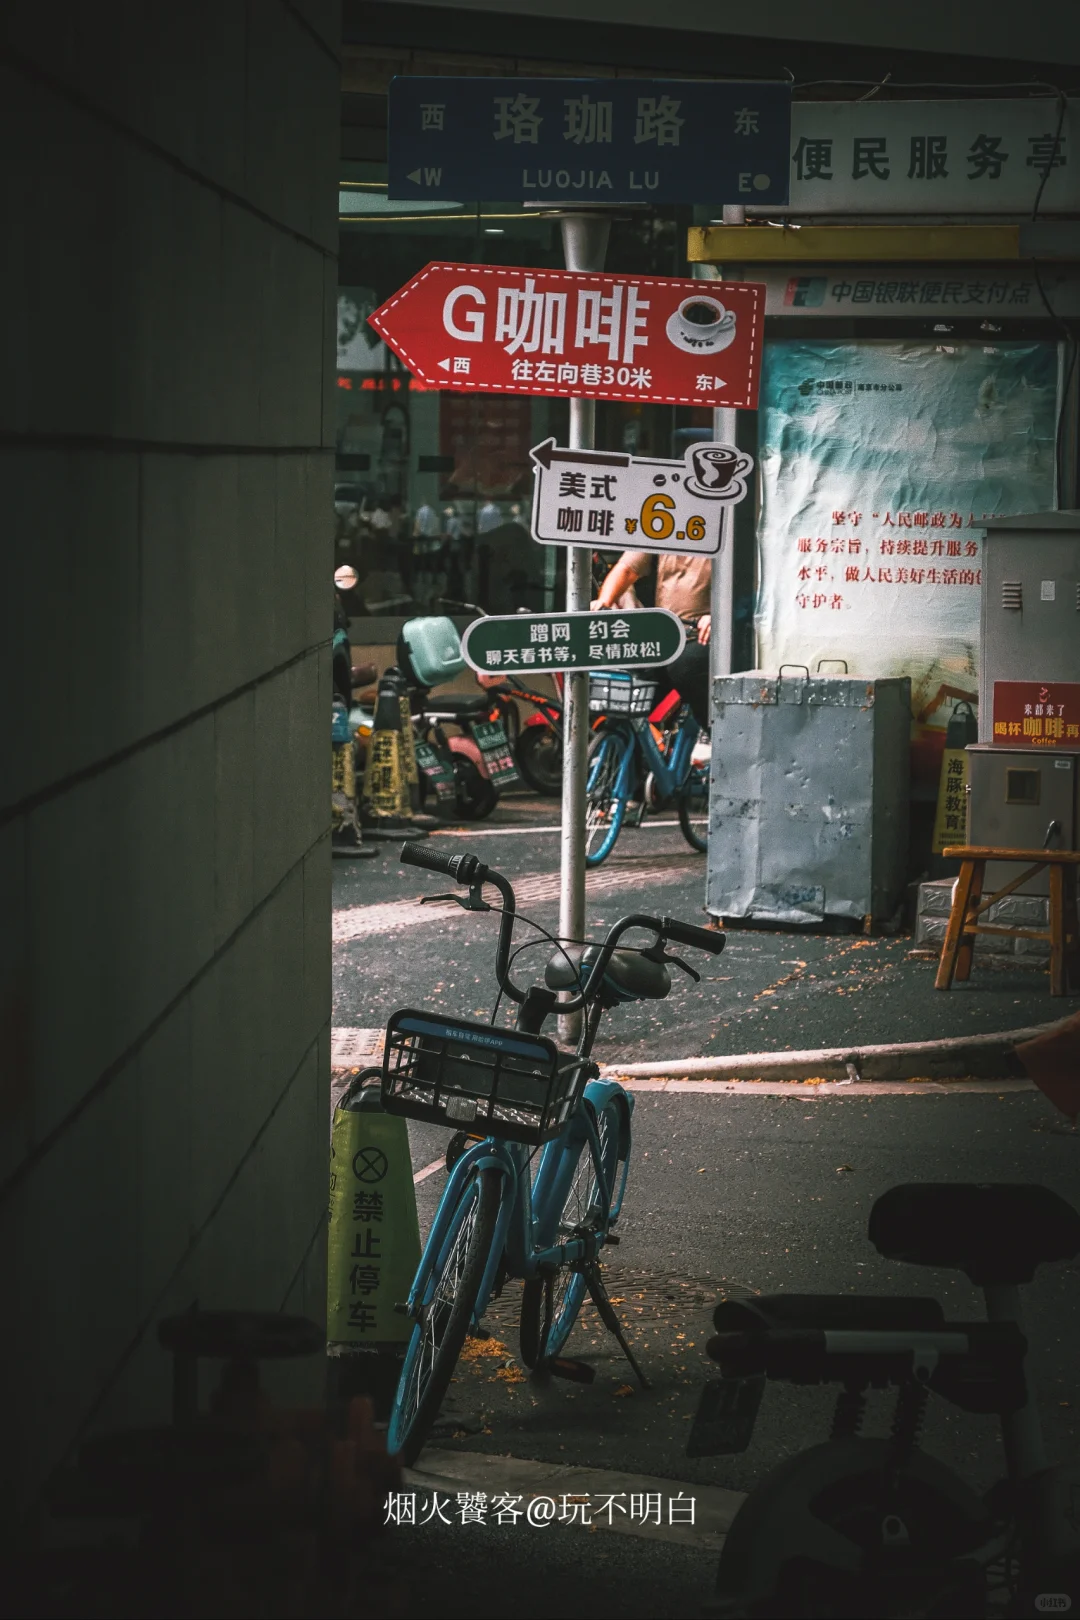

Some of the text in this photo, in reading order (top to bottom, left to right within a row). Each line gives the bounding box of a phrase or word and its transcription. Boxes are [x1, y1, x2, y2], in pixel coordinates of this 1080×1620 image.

[419, 103, 446, 131] 西
[493, 93, 686, 147] 珞珈路
[733, 107, 760, 136] 东
[792, 133, 1068, 182] 便民服务亭
[423, 167, 443, 187] W
[522, 169, 660, 191] LUOJIA LU
[738, 172, 752, 193] E
[830, 279, 1034, 306] 中国银联便民支付点
[442, 278, 651, 364] G咖啡
[453, 356, 471, 375] 西
[511, 359, 653, 390] 往左向巷30米
[695, 373, 713, 391] 东
[558, 471, 618, 501] 美式
[556, 506, 615, 536] 咖啡
[529, 619, 631, 643] 蹭网 约会
[1023, 703, 1065, 717] 来都来了
[944, 758, 965, 830] 海豚教育
[346, 1190, 385, 1333] 禁止停车
